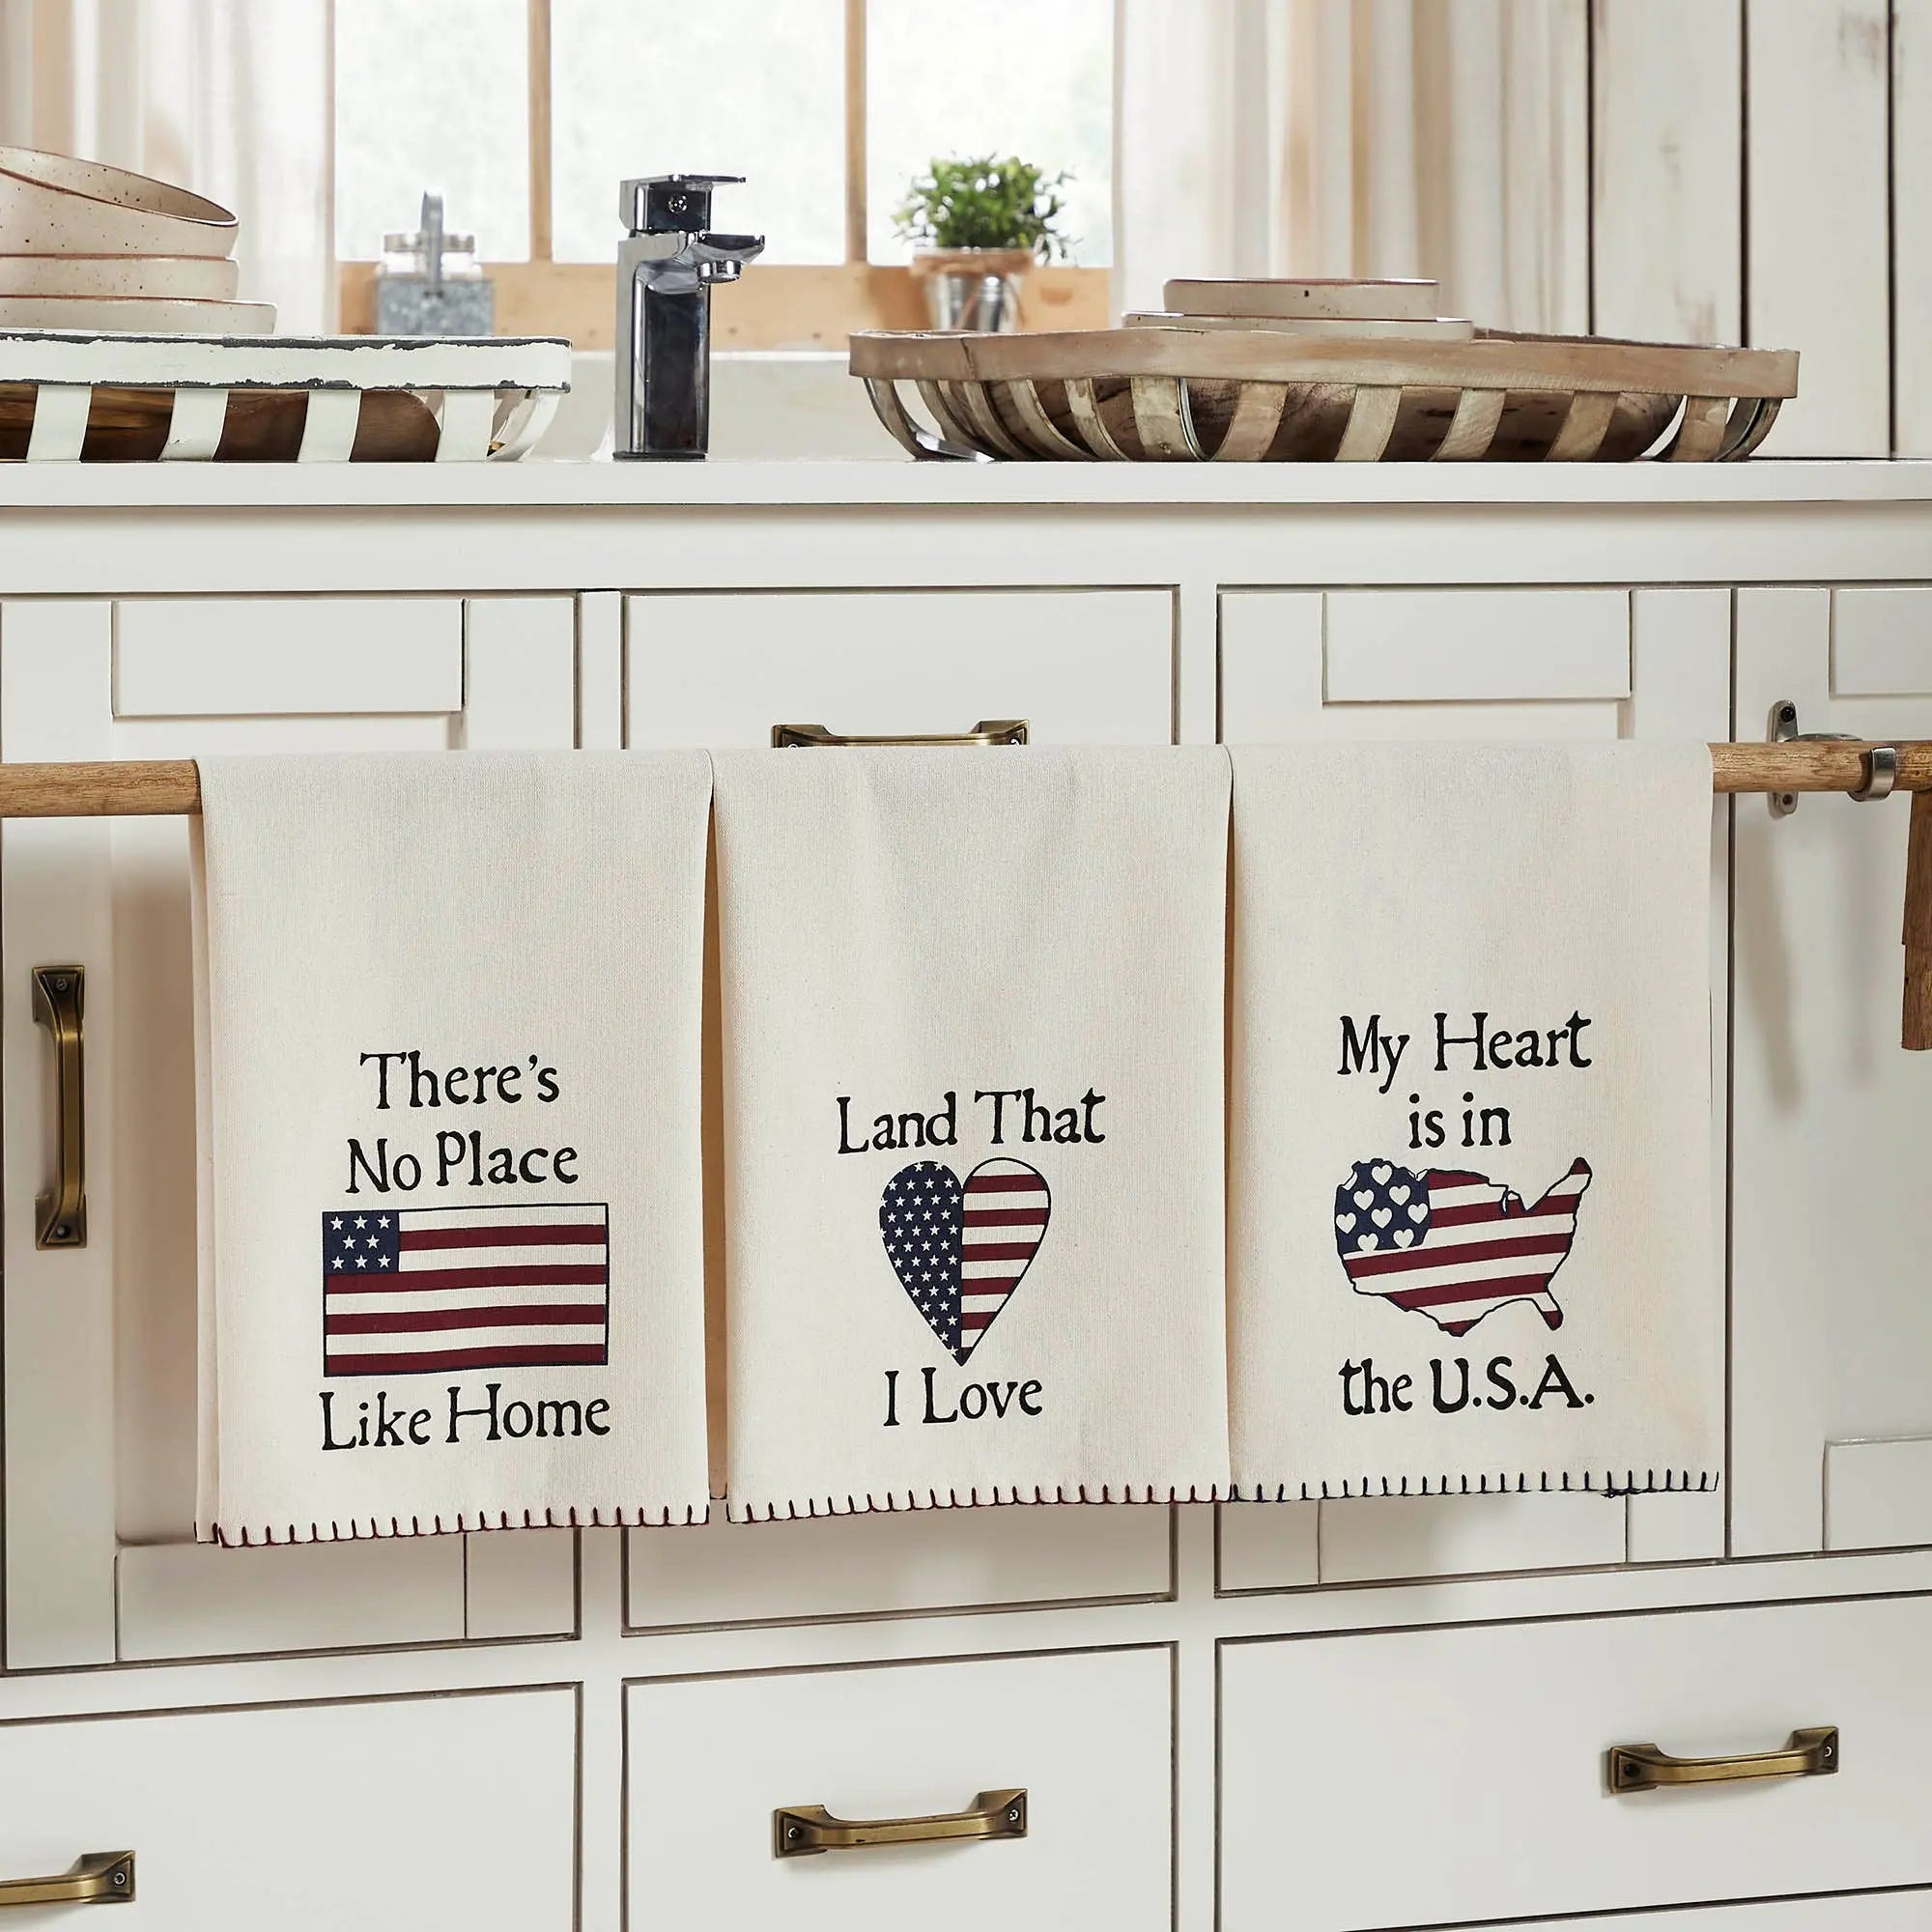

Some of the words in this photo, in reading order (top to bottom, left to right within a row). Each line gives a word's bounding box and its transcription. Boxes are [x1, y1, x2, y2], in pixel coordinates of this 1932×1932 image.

[359, 1050, 560, 1110] There's
[1337, 1015, 1410, 1094] My
[1435, 1010, 1592, 1071] Heart
[837, 1092, 958, 1153] Land
[975, 1087, 1107, 1145] That
[1408, 1094, 1446, 1150] is
[1462, 1092, 1512, 1148] in
[345, 1138, 422, 1194] No
[435, 1130, 579, 1187] Place
[319, 1390, 432, 1451] Like
[445, 1382, 611, 1443] Home
[883, 1370, 900, 1427] I
[922, 1366, 1043, 1424] Love
[1338, 1357, 1413, 1416] the
[1429, 1354, 1595, 1414] U.S.A.
